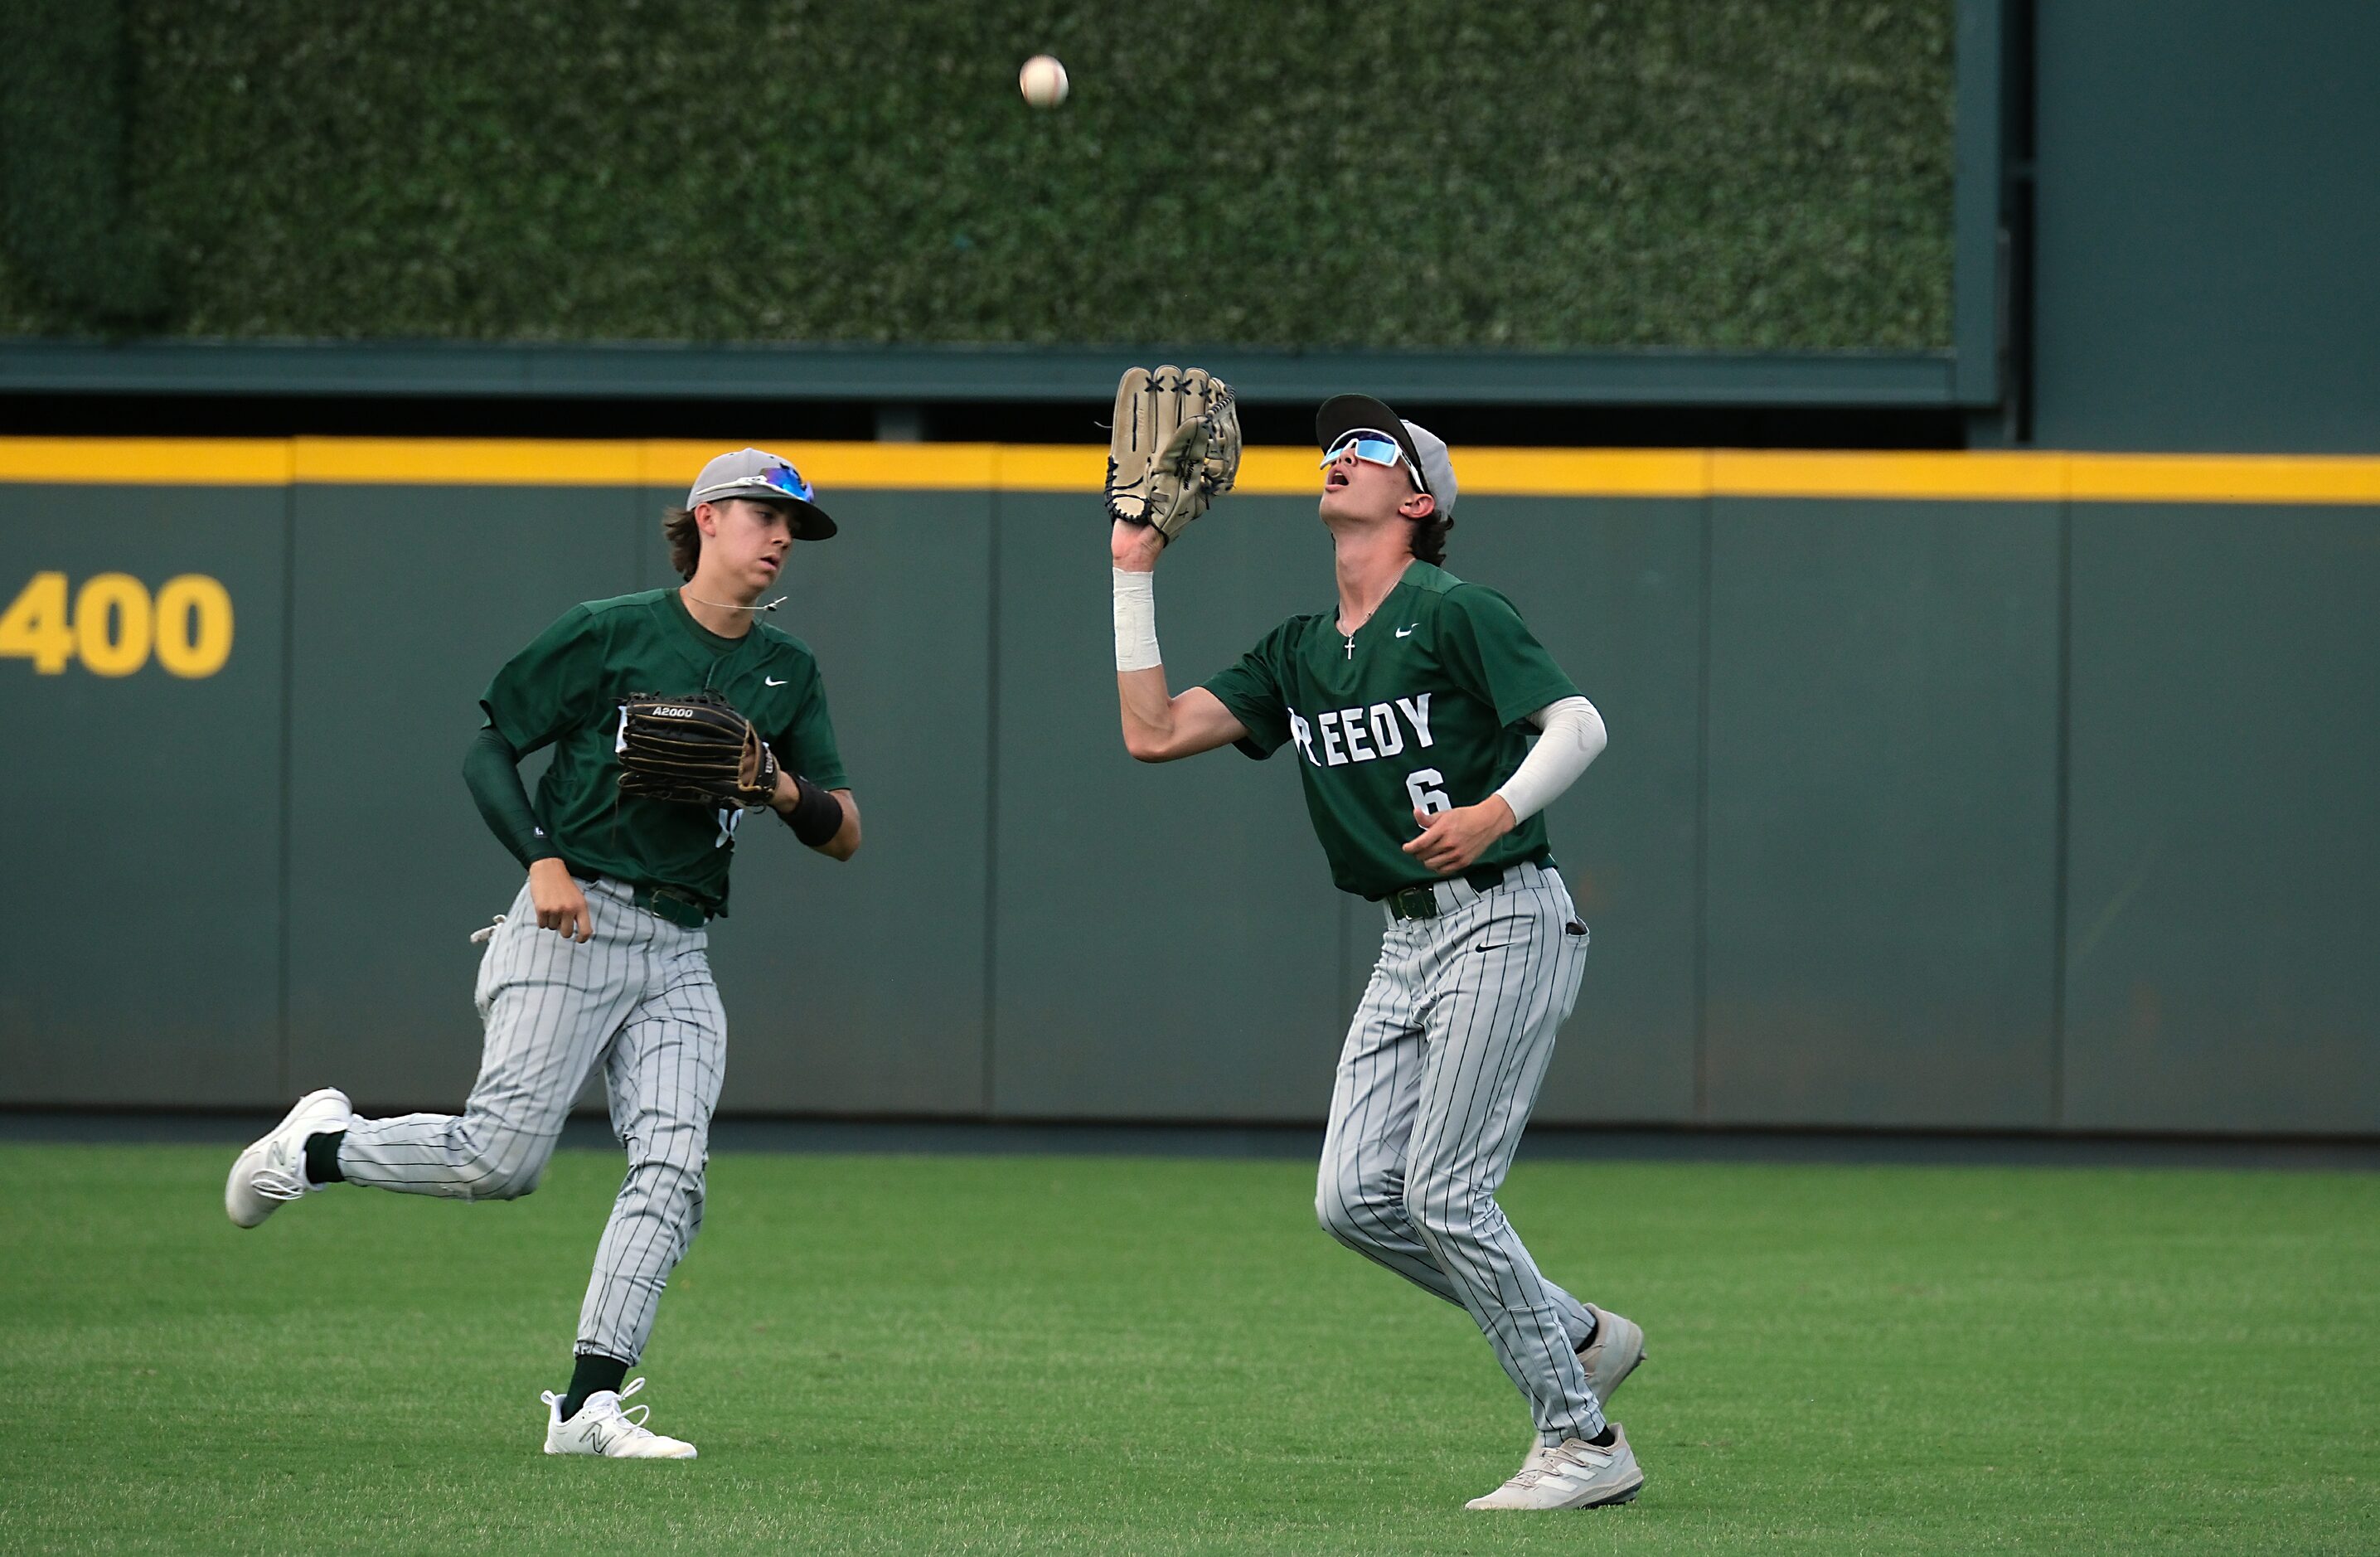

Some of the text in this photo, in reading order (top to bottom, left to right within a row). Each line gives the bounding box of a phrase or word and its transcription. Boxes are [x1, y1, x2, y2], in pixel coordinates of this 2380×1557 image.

[0, 570, 234, 679] 400
[652, 706, 694, 718] A2000
[1287, 692, 1434, 767] REEDY
[1405, 768, 1452, 830] 6
